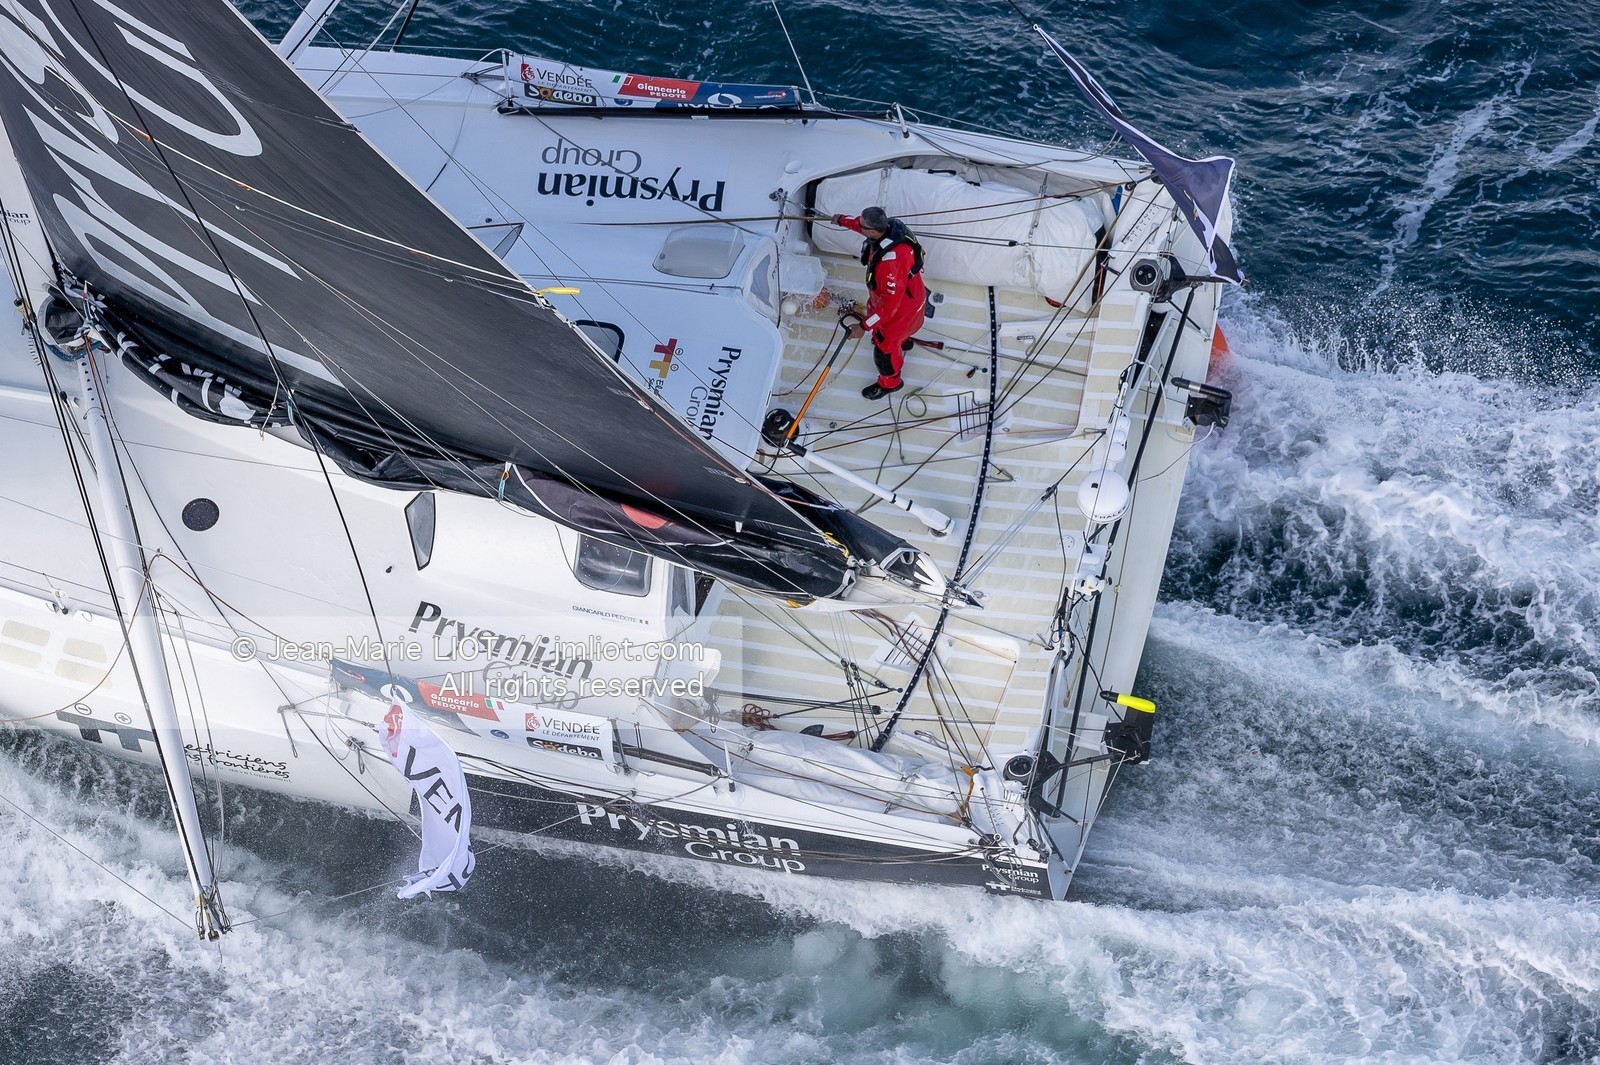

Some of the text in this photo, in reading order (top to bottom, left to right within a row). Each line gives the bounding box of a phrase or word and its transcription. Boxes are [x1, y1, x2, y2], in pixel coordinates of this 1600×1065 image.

[537, 68, 593, 88] VENDÉE
[637, 83, 686, 95] Giancarlo
[542, 139, 642, 174] Group
[537, 167, 726, 212] Prysmian
[699, 346, 742, 440] Prysmian
[572, 605, 611, 618] GIANCARLO
[611, 613, 638, 623] PEDOTE
[408, 601, 593, 680] Prysmian
[430, 693, 479, 708] Giancarlo
[431, 700, 467, 712] PEDOTE
[541, 716, 600, 734] VENDÉE
[551, 731, 600, 741] DÉPARTEMENT
[184, 744, 287, 770] ectriciens
[532, 740, 598, 758] Sodebo
[576, 802, 801, 856] Prysmian
[684, 841, 806, 873] Group
[982, 864, 1039, 878] Pysmian
